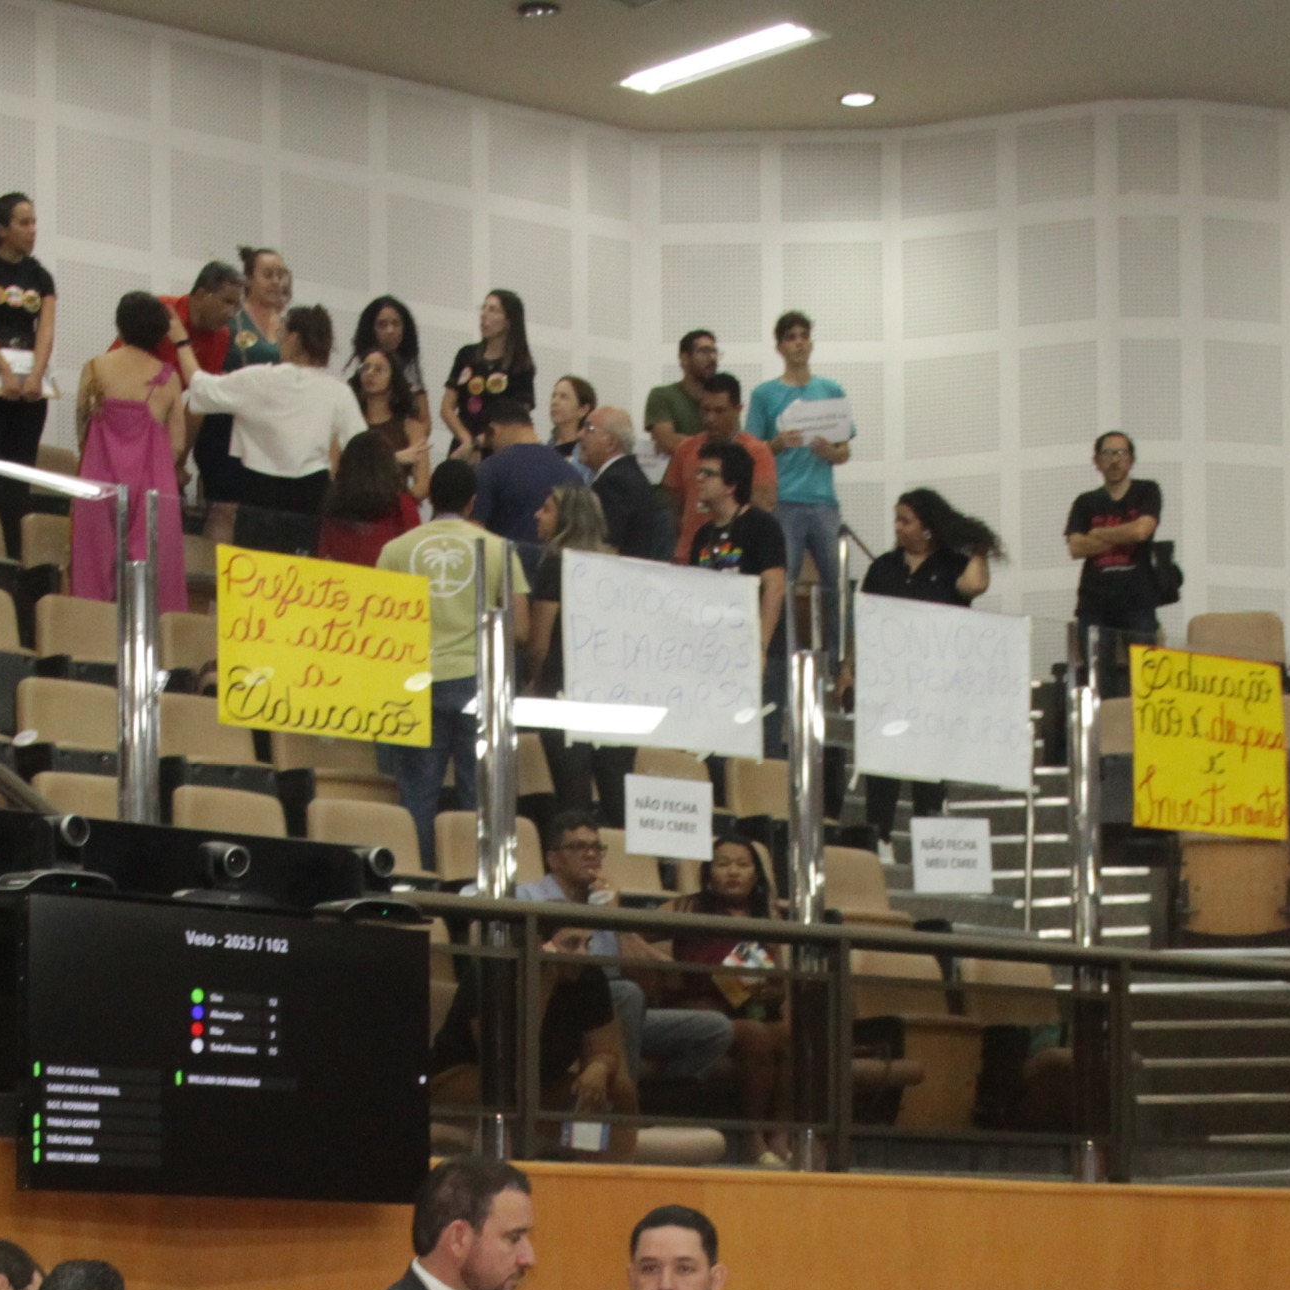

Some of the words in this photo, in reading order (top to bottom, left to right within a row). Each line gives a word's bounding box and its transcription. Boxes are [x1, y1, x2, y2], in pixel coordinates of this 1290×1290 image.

[222, 553, 349, 618] Prefeito
[354, 593, 430, 628] pare
[223, 606, 273, 644] de
[286, 618, 428, 664] atacar
[634, 796, 661, 811] NÃO
[662, 800, 699, 814] FECHA
[184, 930, 216, 948] Veto
[223, 932, 257, 951] 2025
[265, 937, 290, 954] 102
